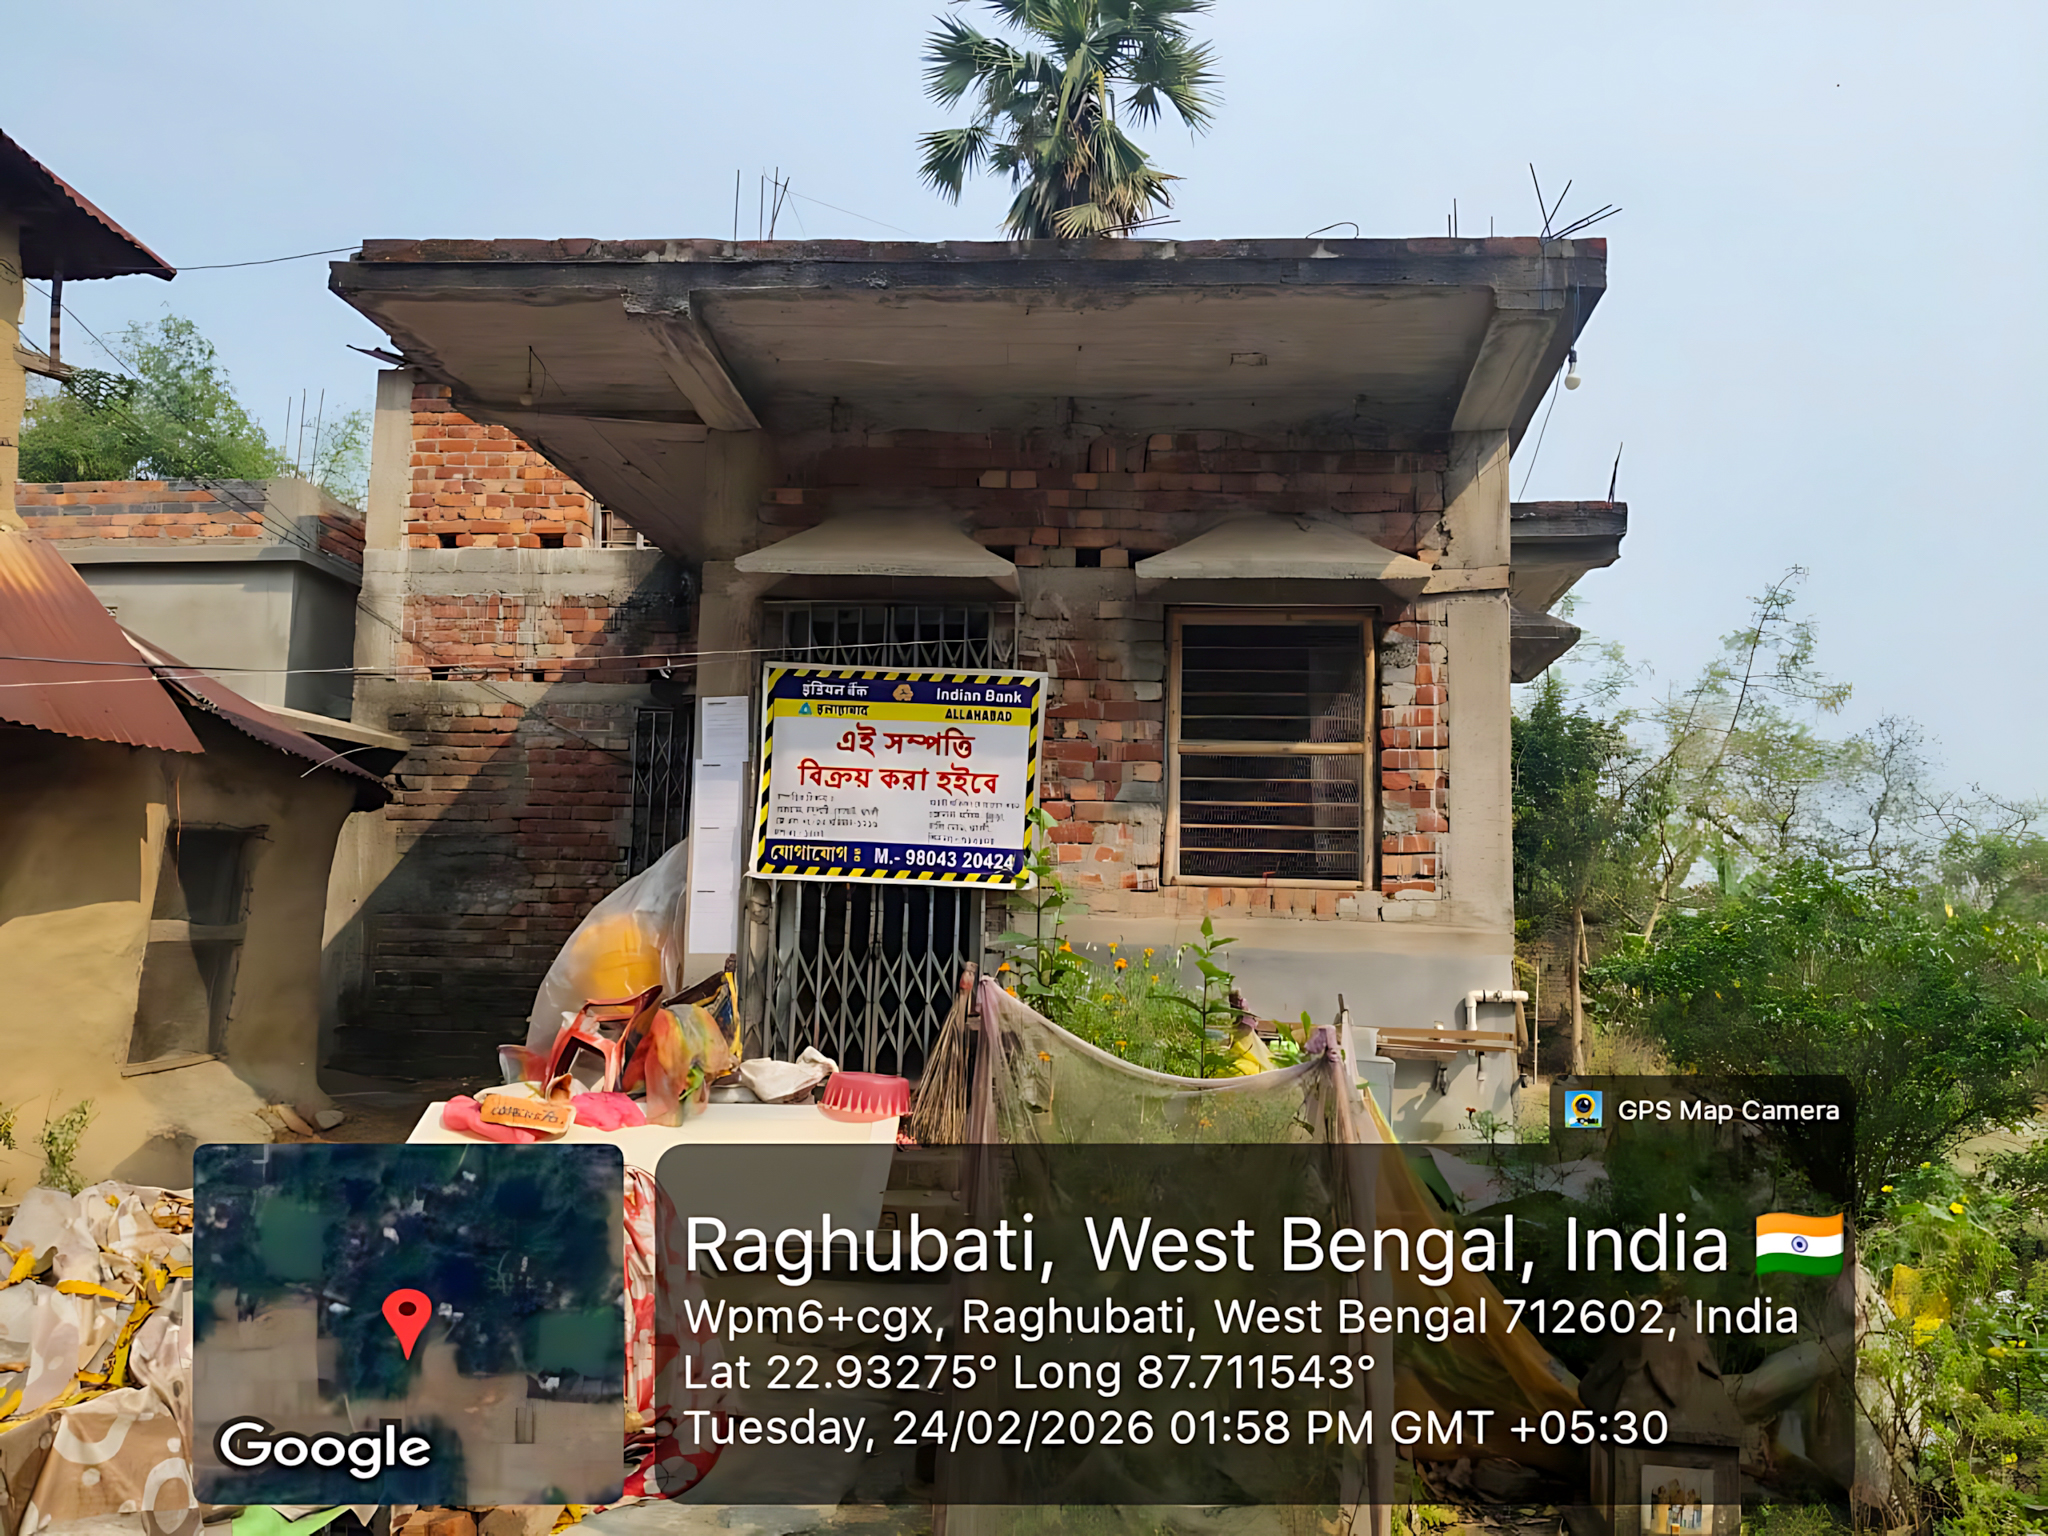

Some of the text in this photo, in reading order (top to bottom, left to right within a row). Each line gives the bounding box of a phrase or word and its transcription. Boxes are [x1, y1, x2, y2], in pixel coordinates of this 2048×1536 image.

[936, 687, 1022, 703] Indian Bank
[945, 708, 1012, 722] ALLAHABAD
[836, 722, 976, 759] এই সম্পত্তি
[797, 757, 999, 797] বিক্রয় করা হইবে
[770, 844, 848, 863] যোগাযোগ
[905, 849, 957, 867] 98043
[962, 851, 1014, 870] 20424
